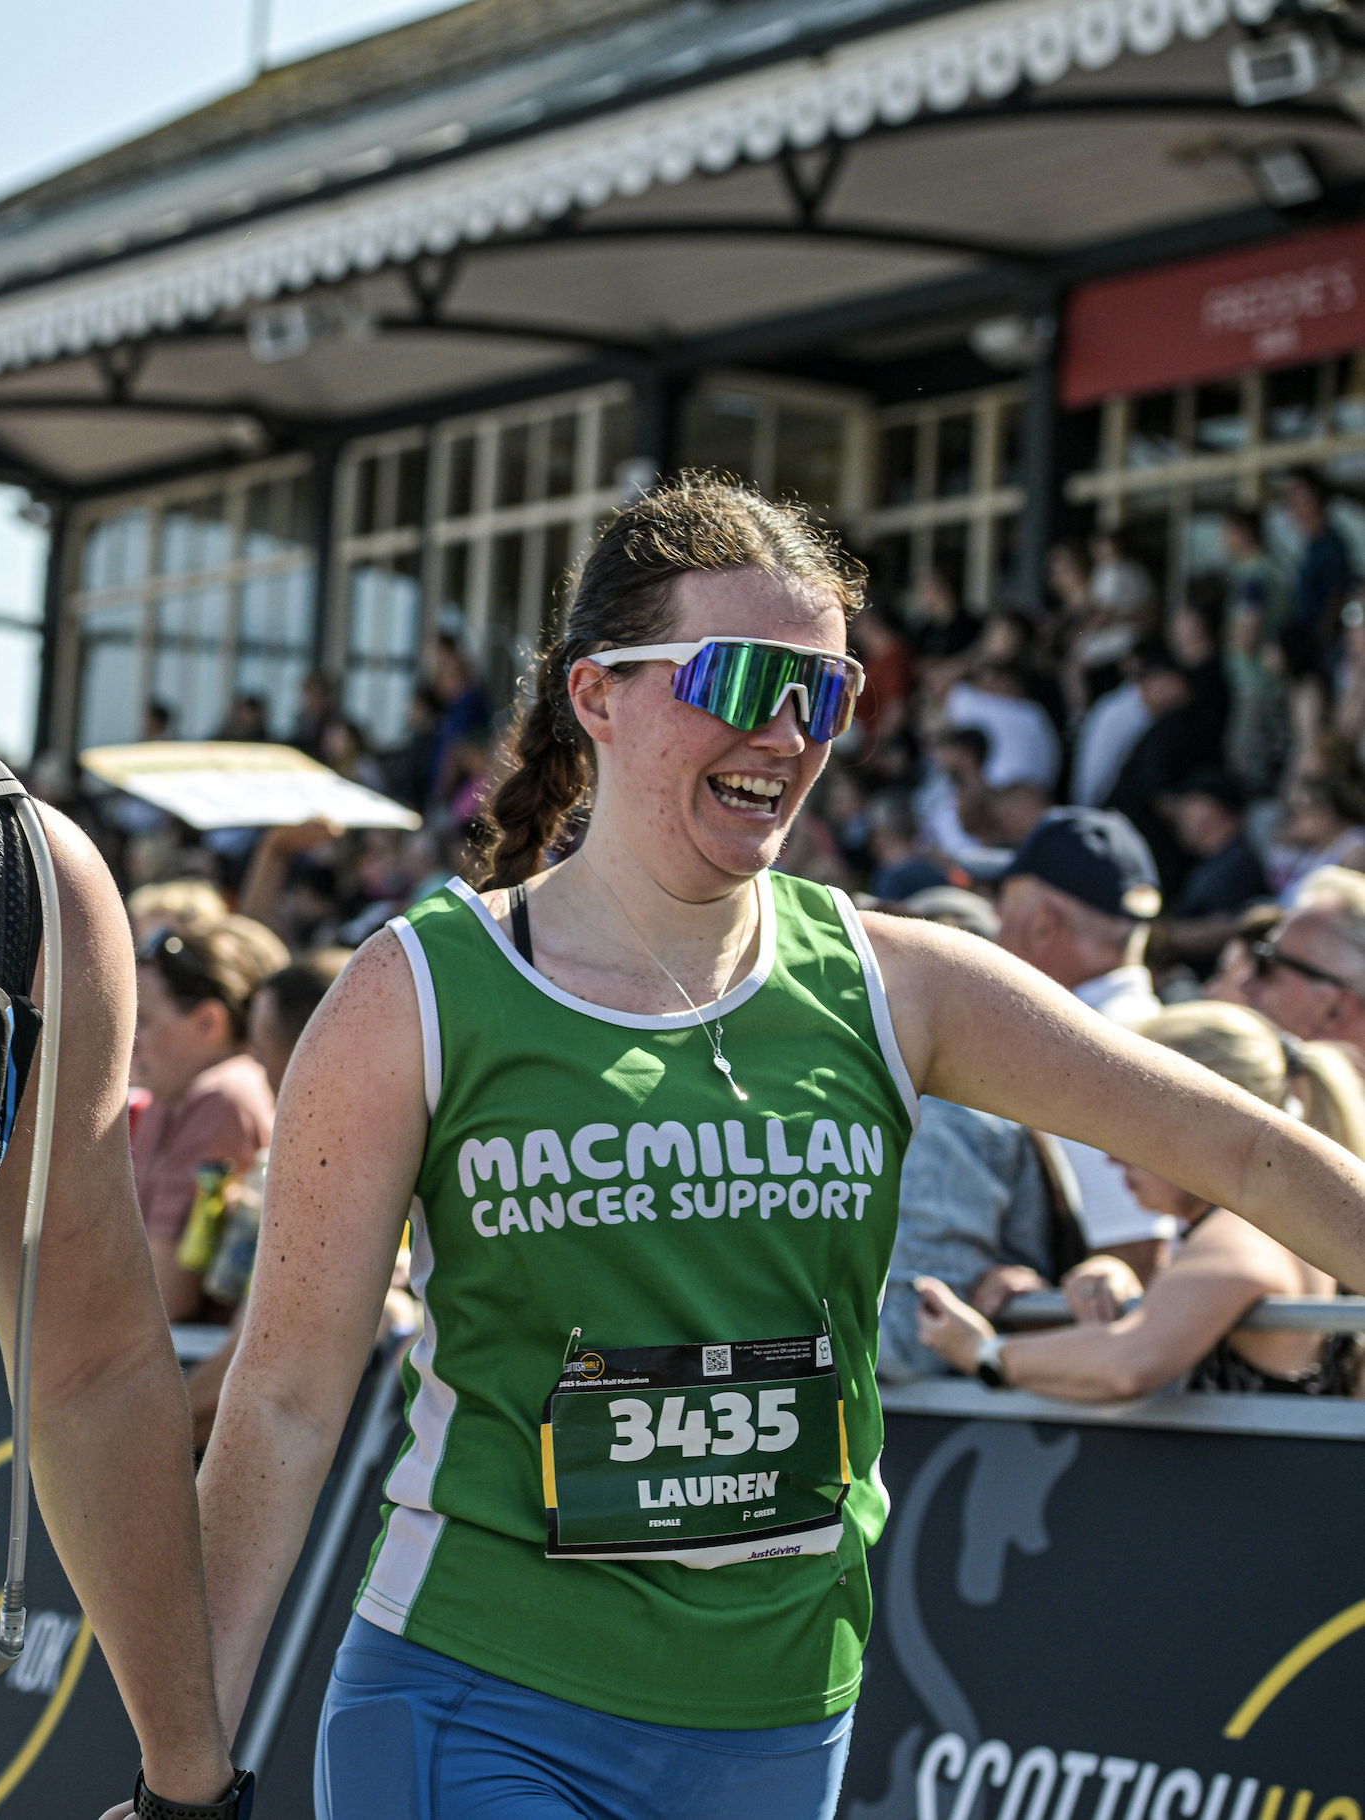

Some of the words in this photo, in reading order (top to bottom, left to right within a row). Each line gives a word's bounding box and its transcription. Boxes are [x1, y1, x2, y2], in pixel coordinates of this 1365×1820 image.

[457, 1118, 884, 1198] MACMILLAN
[471, 1184, 657, 1238] CANCER
[670, 1179, 872, 1221] SUPPORT
[575, 1379, 602, 1387] Scottish
[608, 1388, 800, 1462] 3435
[637, 1470, 779, 1509] LAUREN
[649, 1518, 681, 1528] FEMALE
[753, 1507, 776, 1518] GREEN
[747, 1545, 801, 1559] JustGiving
